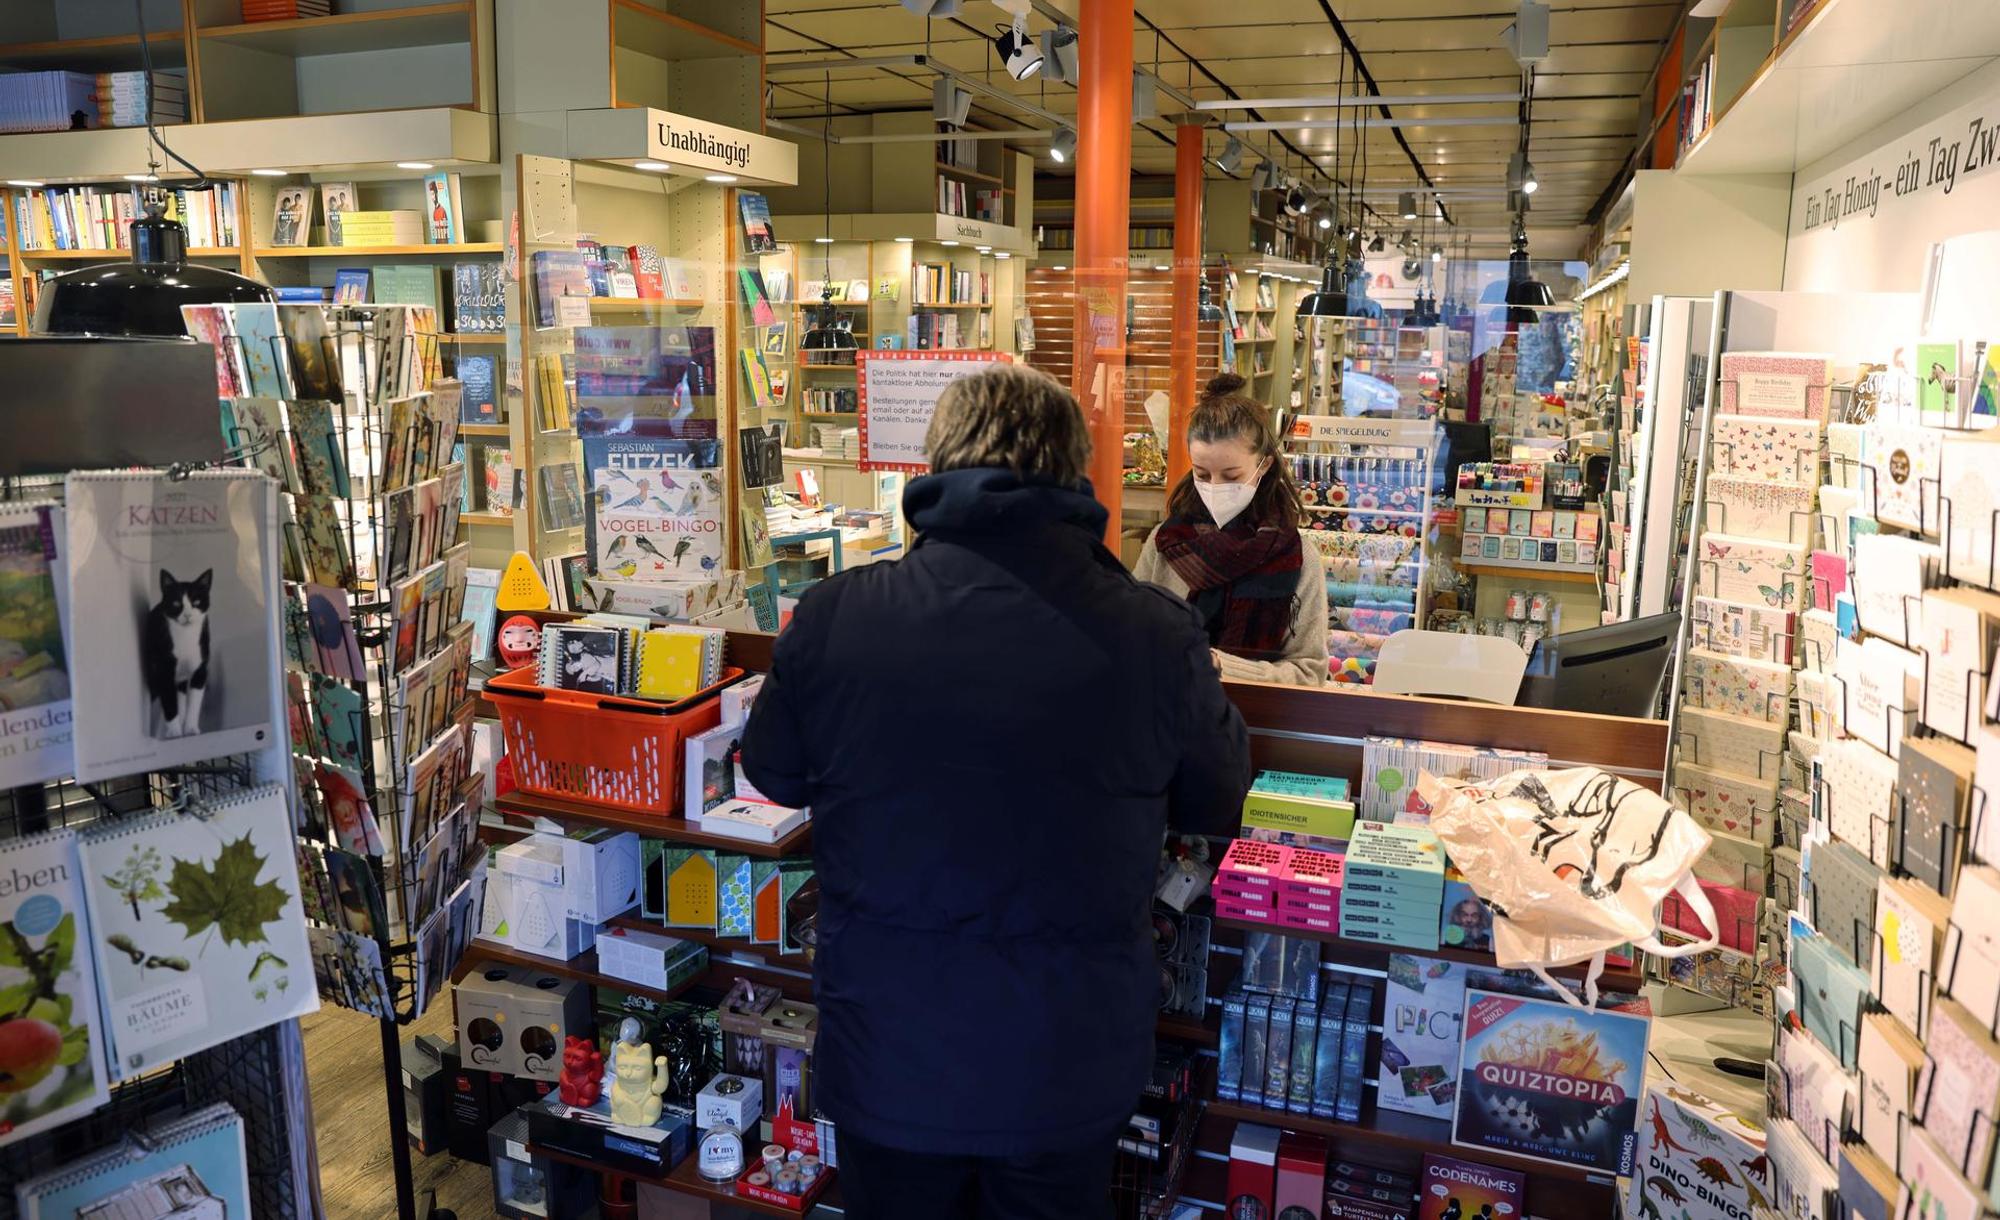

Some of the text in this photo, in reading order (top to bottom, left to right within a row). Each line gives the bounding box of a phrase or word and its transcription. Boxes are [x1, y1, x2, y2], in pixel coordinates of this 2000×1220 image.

[658, 123, 750, 168] Unabhängig!
[1805, 194, 1820, 230] Ein
[1824, 188, 1841, 230] Tag
[1842, 168, 1881, 218] Honig
[1895, 150, 1920, 197] ein
[1926, 137, 1961, 194] Tag
[957, 224, 982, 239] Sachbuch
[872, 379, 912, 387] kontaktlose
[1320, 427, 1390, 437] DIE SPIEGELBURG
[607, 443, 654, 452] SEBASTIAN
[128, 505, 218, 526] KATZEN
[600, 520, 717, 533] VOGEL-BINGO
[0, 708, 72, 737] lende
[1250, 809, 1308, 823] IDIOTENSICHER
[1482, 1007, 1505, 1025] QUIZ!
[1482, 1065, 1617, 1104] QUIZTOPIA
[720, 1146, 735, 1156] my
[1620, 1134, 1634, 1175] KOSMOS
[1429, 1165, 1516, 1194] CODENAMES
[1650, 1154, 1753, 1220] DINO-BINGO
[1343, 1205, 1383, 1220] RAMPENSAU
